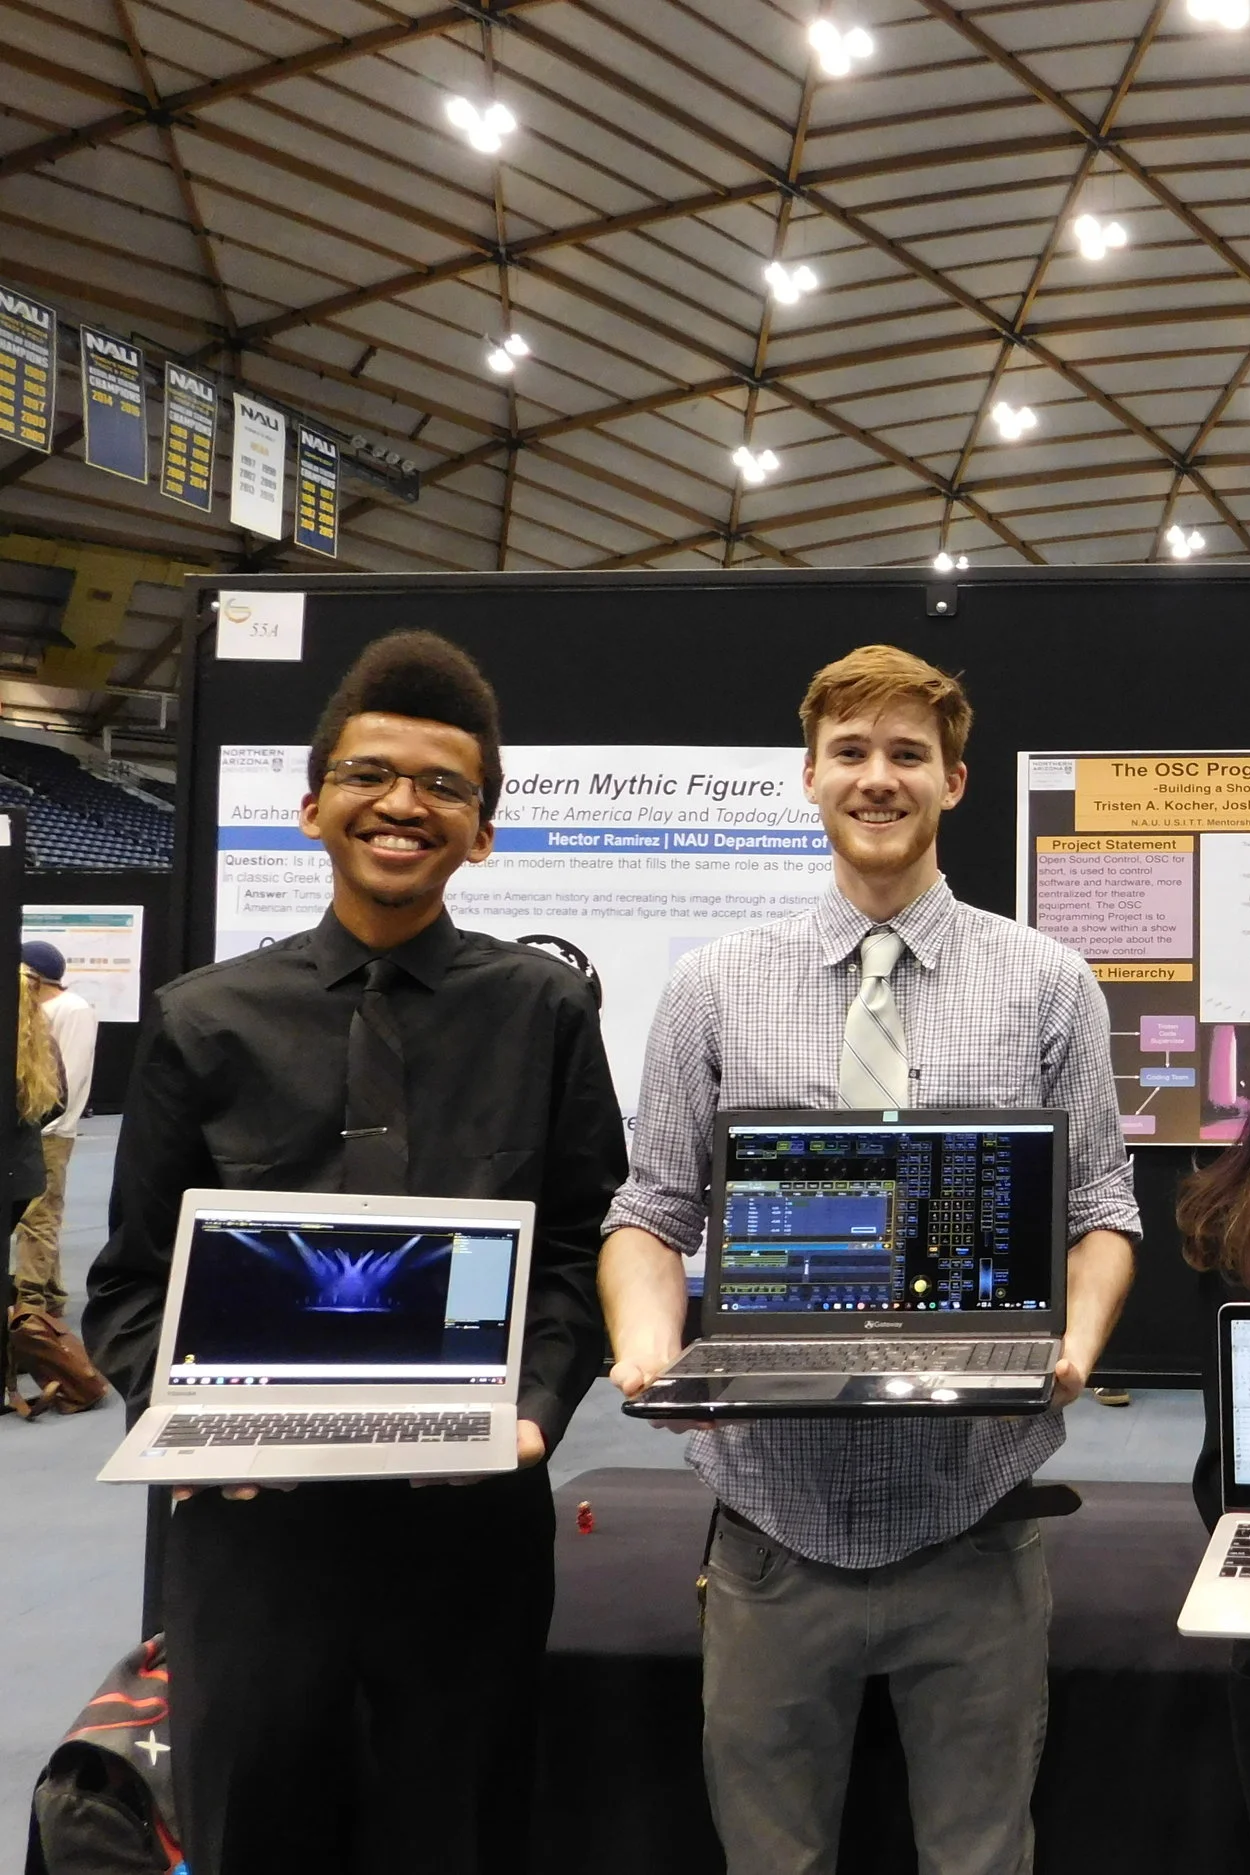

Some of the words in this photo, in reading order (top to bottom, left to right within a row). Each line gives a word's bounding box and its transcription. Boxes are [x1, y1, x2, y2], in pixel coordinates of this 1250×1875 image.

[0, 292, 49, 329] NAU
[86, 332, 138, 368] NAU
[170, 369, 213, 402] NAU
[240, 404, 279, 432] NAU
[301, 430, 337, 458] NAU
[222, 758, 270, 766] ARIZONA
[1111, 762, 1148, 777] The
[1155, 762, 1199, 777] OSC
[504, 773, 580, 795] odern
[589, 773, 678, 801] Mythic
[686, 773, 785, 802] Figure:
[1153, 783, 1211, 796] -Building
[1094, 800, 1141, 811] Tristen
[1146, 800, 1159, 811] A.
[1164, 800, 1218, 813] Kocher,
[494, 806, 526, 821] rks'
[531, 806, 560, 821] The
[564, 806, 633, 822] America
[637, 807, 673, 824] Play
[678, 807, 709, 822] and
[548, 832, 601, 847] Hector
[604, 832, 660, 847] Ramirez
[673, 832, 709, 847] NAU
[714, 833, 808, 850] Department
[811, 834, 828, 848] of
[1052, 839, 1101, 852] Project
[1105, 839, 1177, 850] Statement
[225, 854, 288, 867] Question:
[293, 855, 303, 865] Is
[307, 854, 316, 865] it
[504, 857, 514, 868] in
[518, 858, 565, 869] modern
[569, 857, 613, 869] theatre
[618, 857, 641, 869] that
[646, 858, 666, 869] fills
[670, 858, 690, 869] the
[695, 861, 730, 870] same
[735, 859, 759, 870] role
[763, 862, 779, 871] as
[783, 859, 804, 871] the
[1039, 856, 1066, 865] Open
[1069, 855, 1101, 864] Sound
[1103, 855, 1142, 865] Control,
[1145, 855, 1169, 863] OSC
[1172, 855, 1185, 863] for
[237, 872, 279, 883] classic
[283, 872, 320, 883] Greek
[1039, 867, 1066, 876] short,
[1070, 867, 1077, 875] is
[1080, 867, 1104, 875] used
[1107, 867, 1117, 875] to
[1119, 866, 1153, 875] control
[1039, 878, 1080, 886] software
[1083, 878, 1102, 886] and
[1105, 878, 1154, 887] hardware,
[461, 892, 490, 903] figure
[504, 892, 551, 901] American
[555, 892, 590, 904] history
[593, 893, 612, 902] and
[671, 894, 686, 904] his
[689, 895, 721, 905] image
[725, 895, 766, 905] through
[1039, 890, 1092, 898] centralized
[1095, 889, 1107, 897] for
[1111, 889, 1145, 897] theatre
[1097, 901, 1115, 909] The
[1118, 901, 1142, 909] OSC
[451, 905, 480, 915] Parks
[483, 907, 530, 917] manages
[533, 906, 543, 915] to
[546, 906, 579, 916] create
[591, 906, 634, 918] mythical
[637, 907, 667, 919] figure
[670, 908, 690, 917] that
[711, 909, 747, 919] accept
[750, 910, 763, 918] as
[1039, 912, 1105, 923] Programming
[1108, 912, 1142, 922] Project
[1145, 912, 1153, 920] is
[1157, 912, 1165, 920] to
[1039, 924, 1069, 932] create
[1081, 924, 1107, 932] show
[1110, 924, 1138, 932] within
[1151, 924, 1177, 932] show
[1060, 935, 1087, 944] teach
[1090, 936, 1122, 945] people
[1126, 935, 1153, 943] about
[1157, 935, 1172, 943] the
[1084, 947, 1110, 955] show
[1108, 967, 1175, 980] Hierarchy
